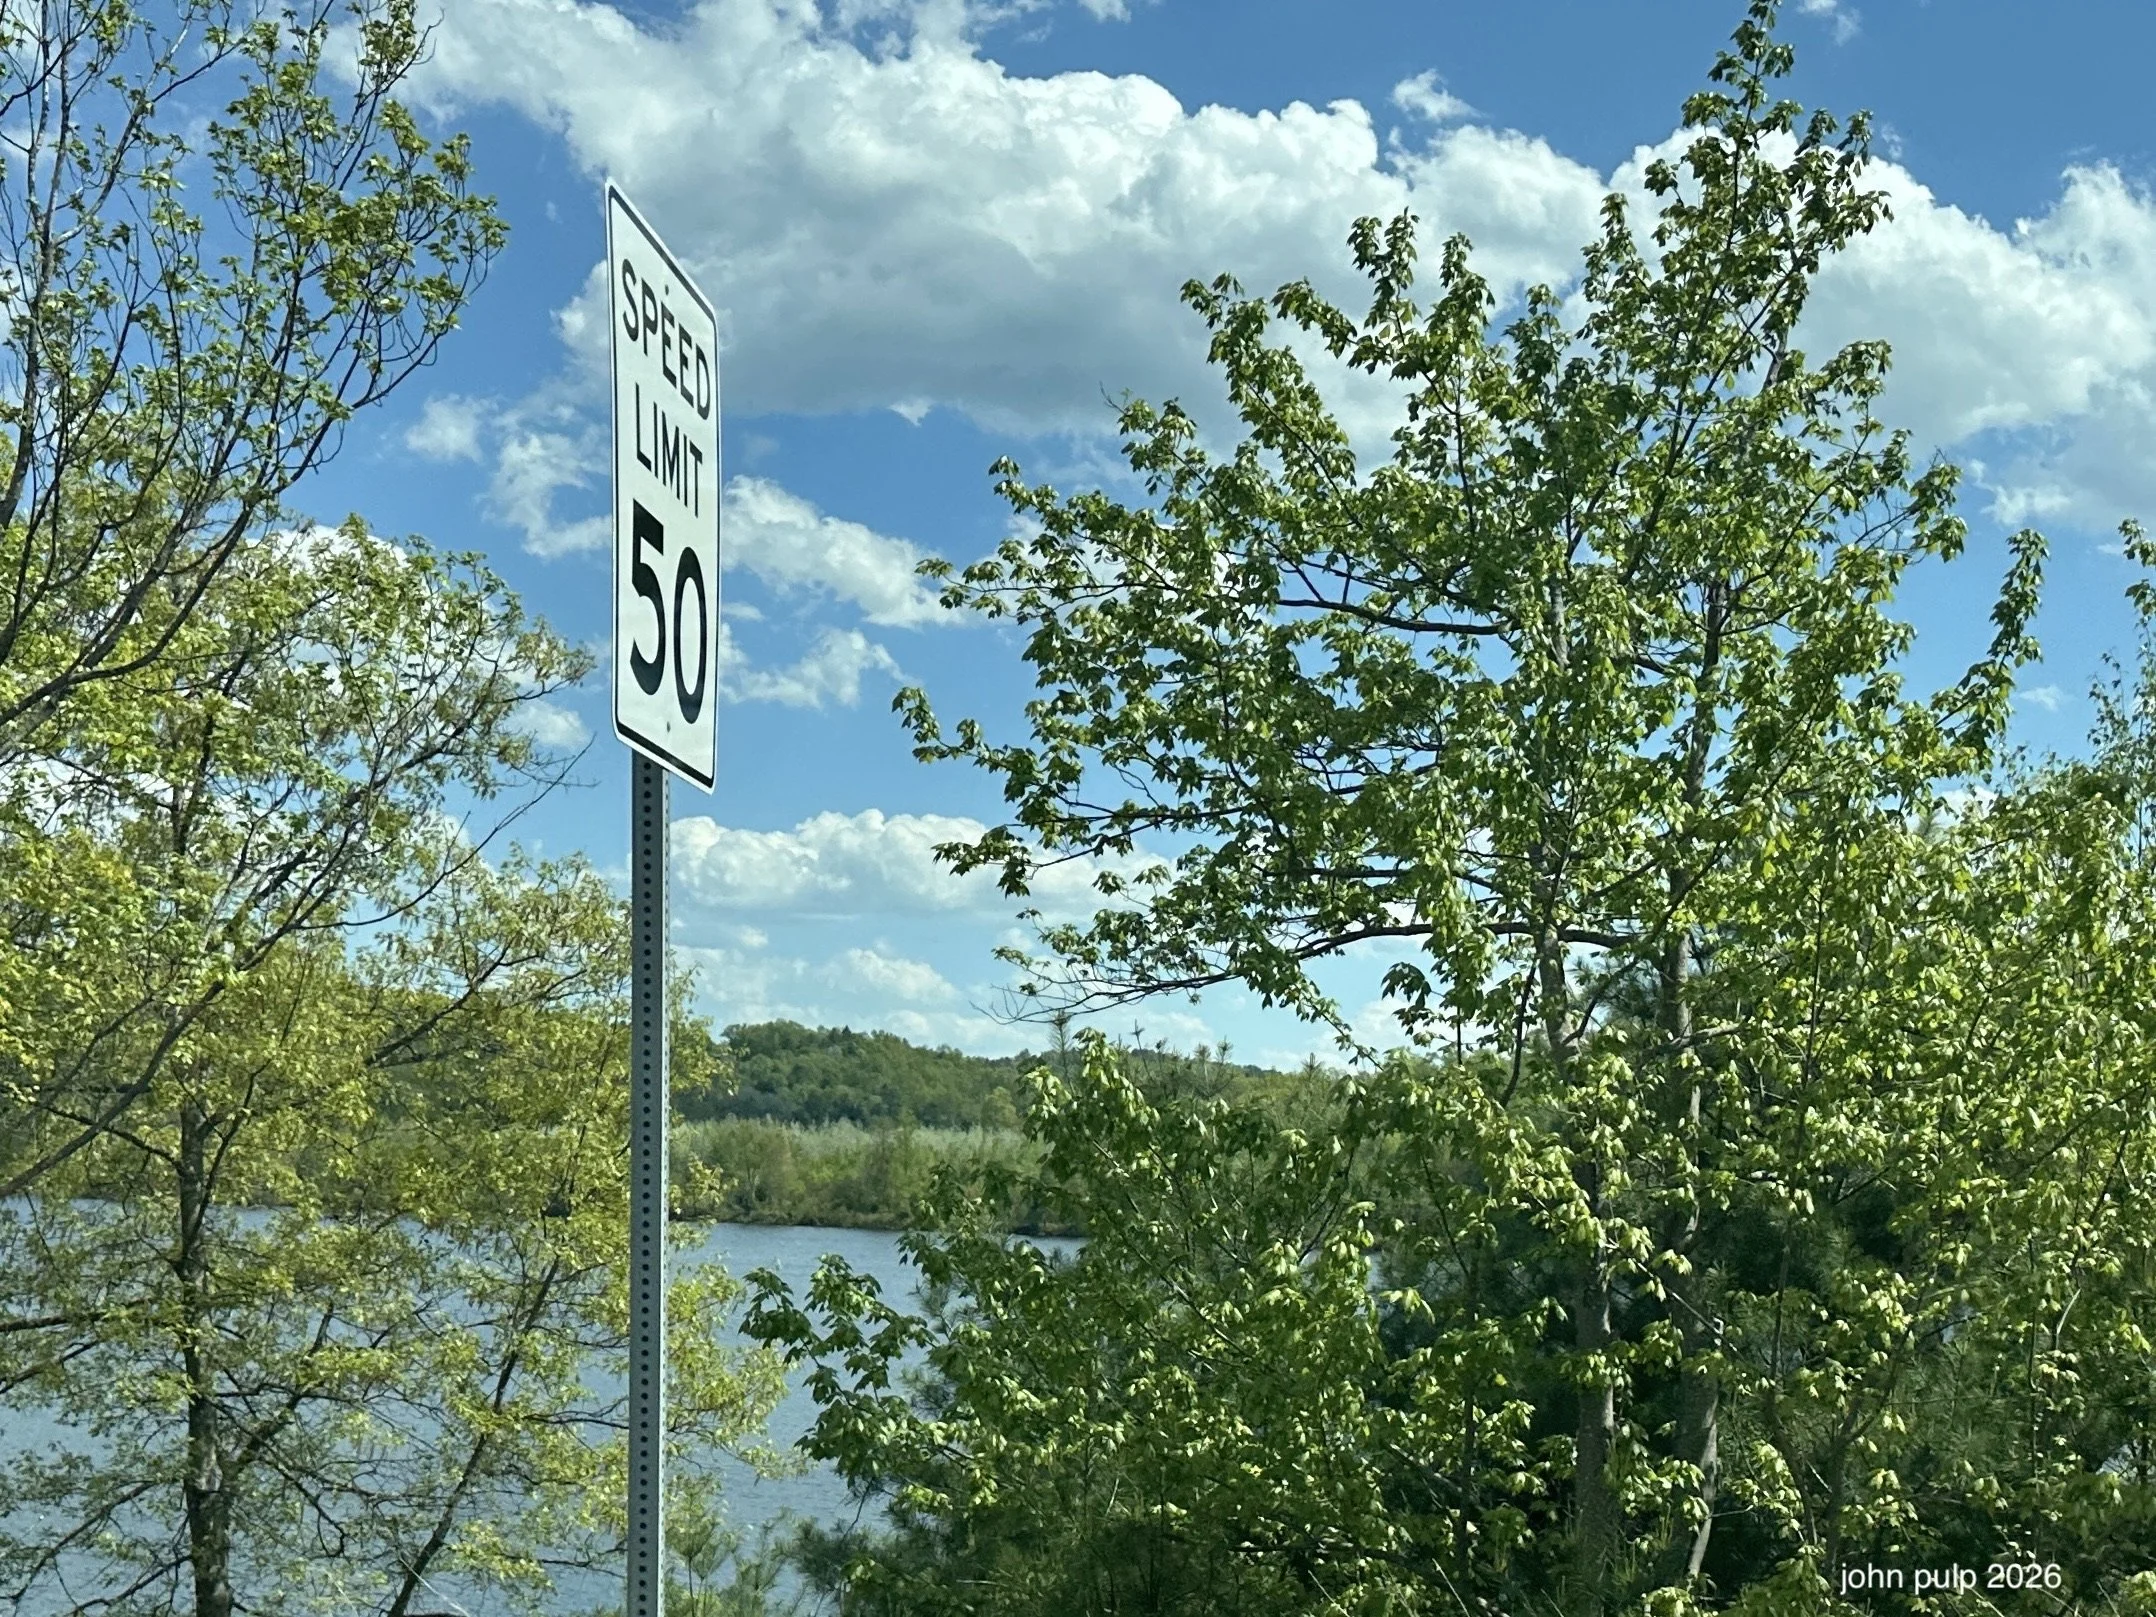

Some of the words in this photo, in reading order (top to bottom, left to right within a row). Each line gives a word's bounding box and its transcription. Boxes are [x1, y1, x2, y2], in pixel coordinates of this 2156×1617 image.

[622, 258, 711, 420] SPEED
[635, 382, 703, 518] LIMIT
[630, 498, 707, 725] 50
